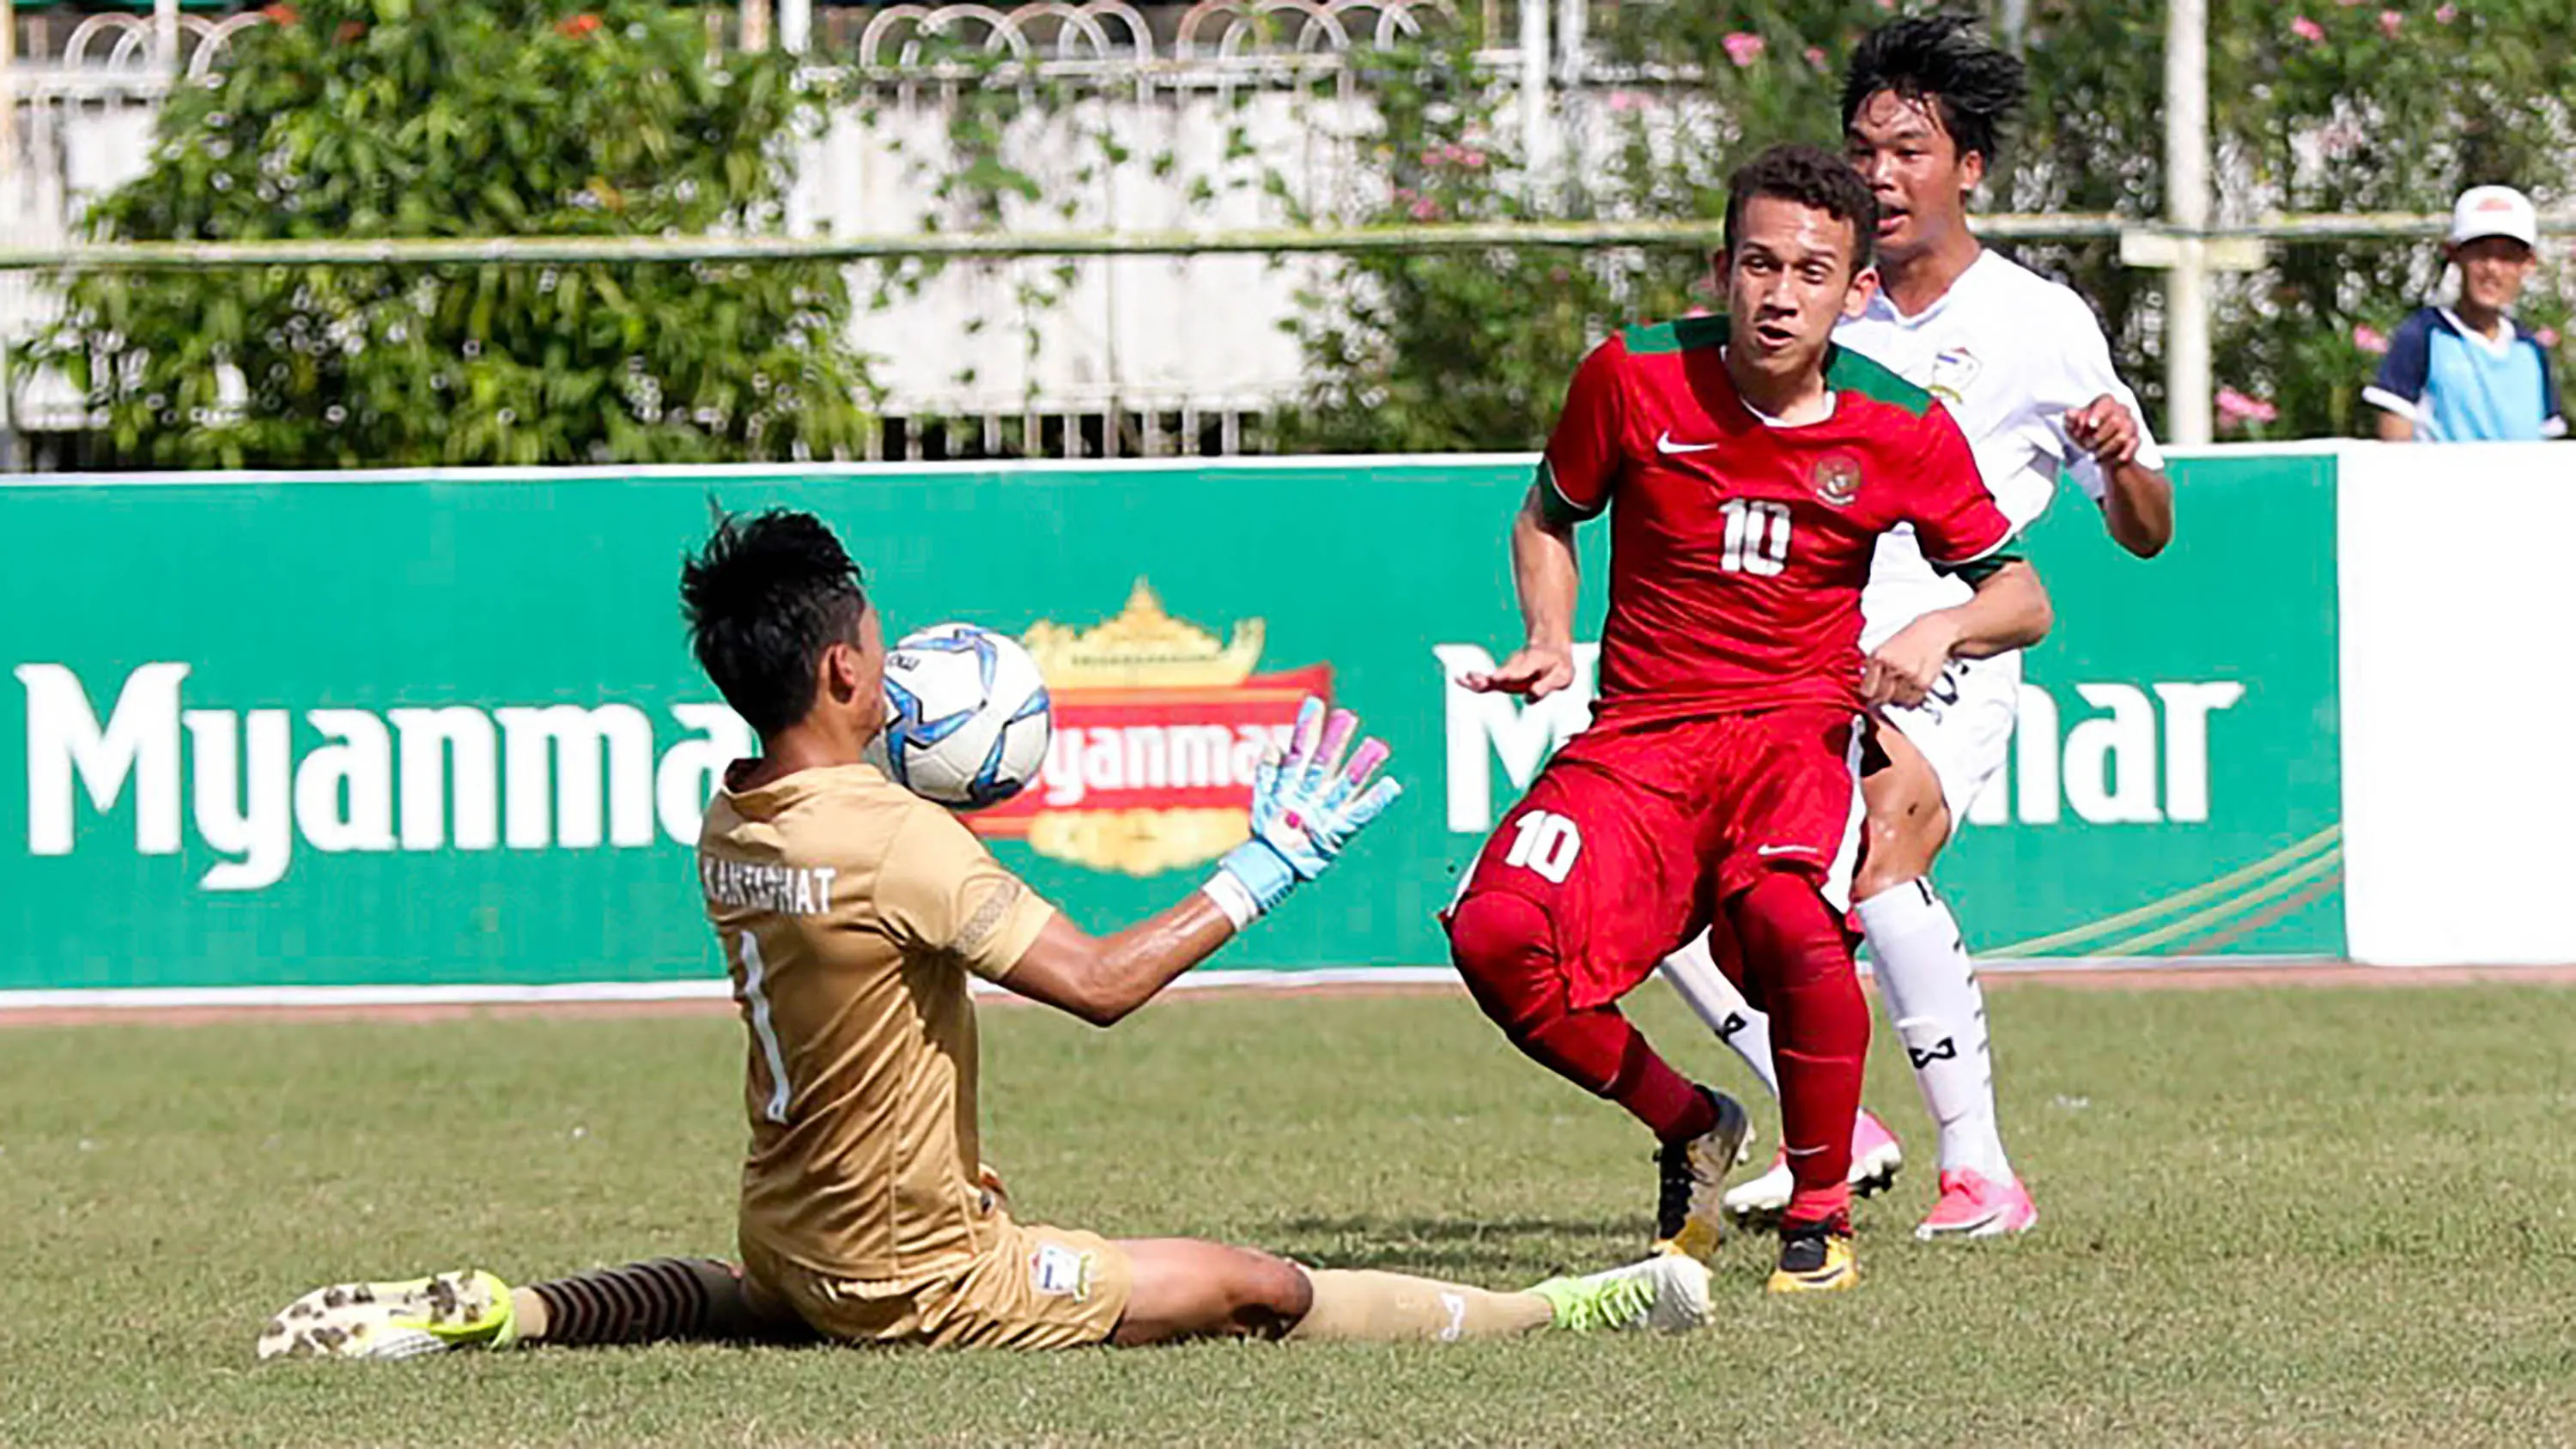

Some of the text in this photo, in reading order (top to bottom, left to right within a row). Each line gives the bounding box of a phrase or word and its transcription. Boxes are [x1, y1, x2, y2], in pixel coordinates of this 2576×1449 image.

[1718, 498, 1791, 576] 10
[13, 661, 766, 890] Myanma
[1025, 724, 1297, 806] yanma
[1504, 809, 1582, 883] 10
[740, 930, 792, 1125] 1
